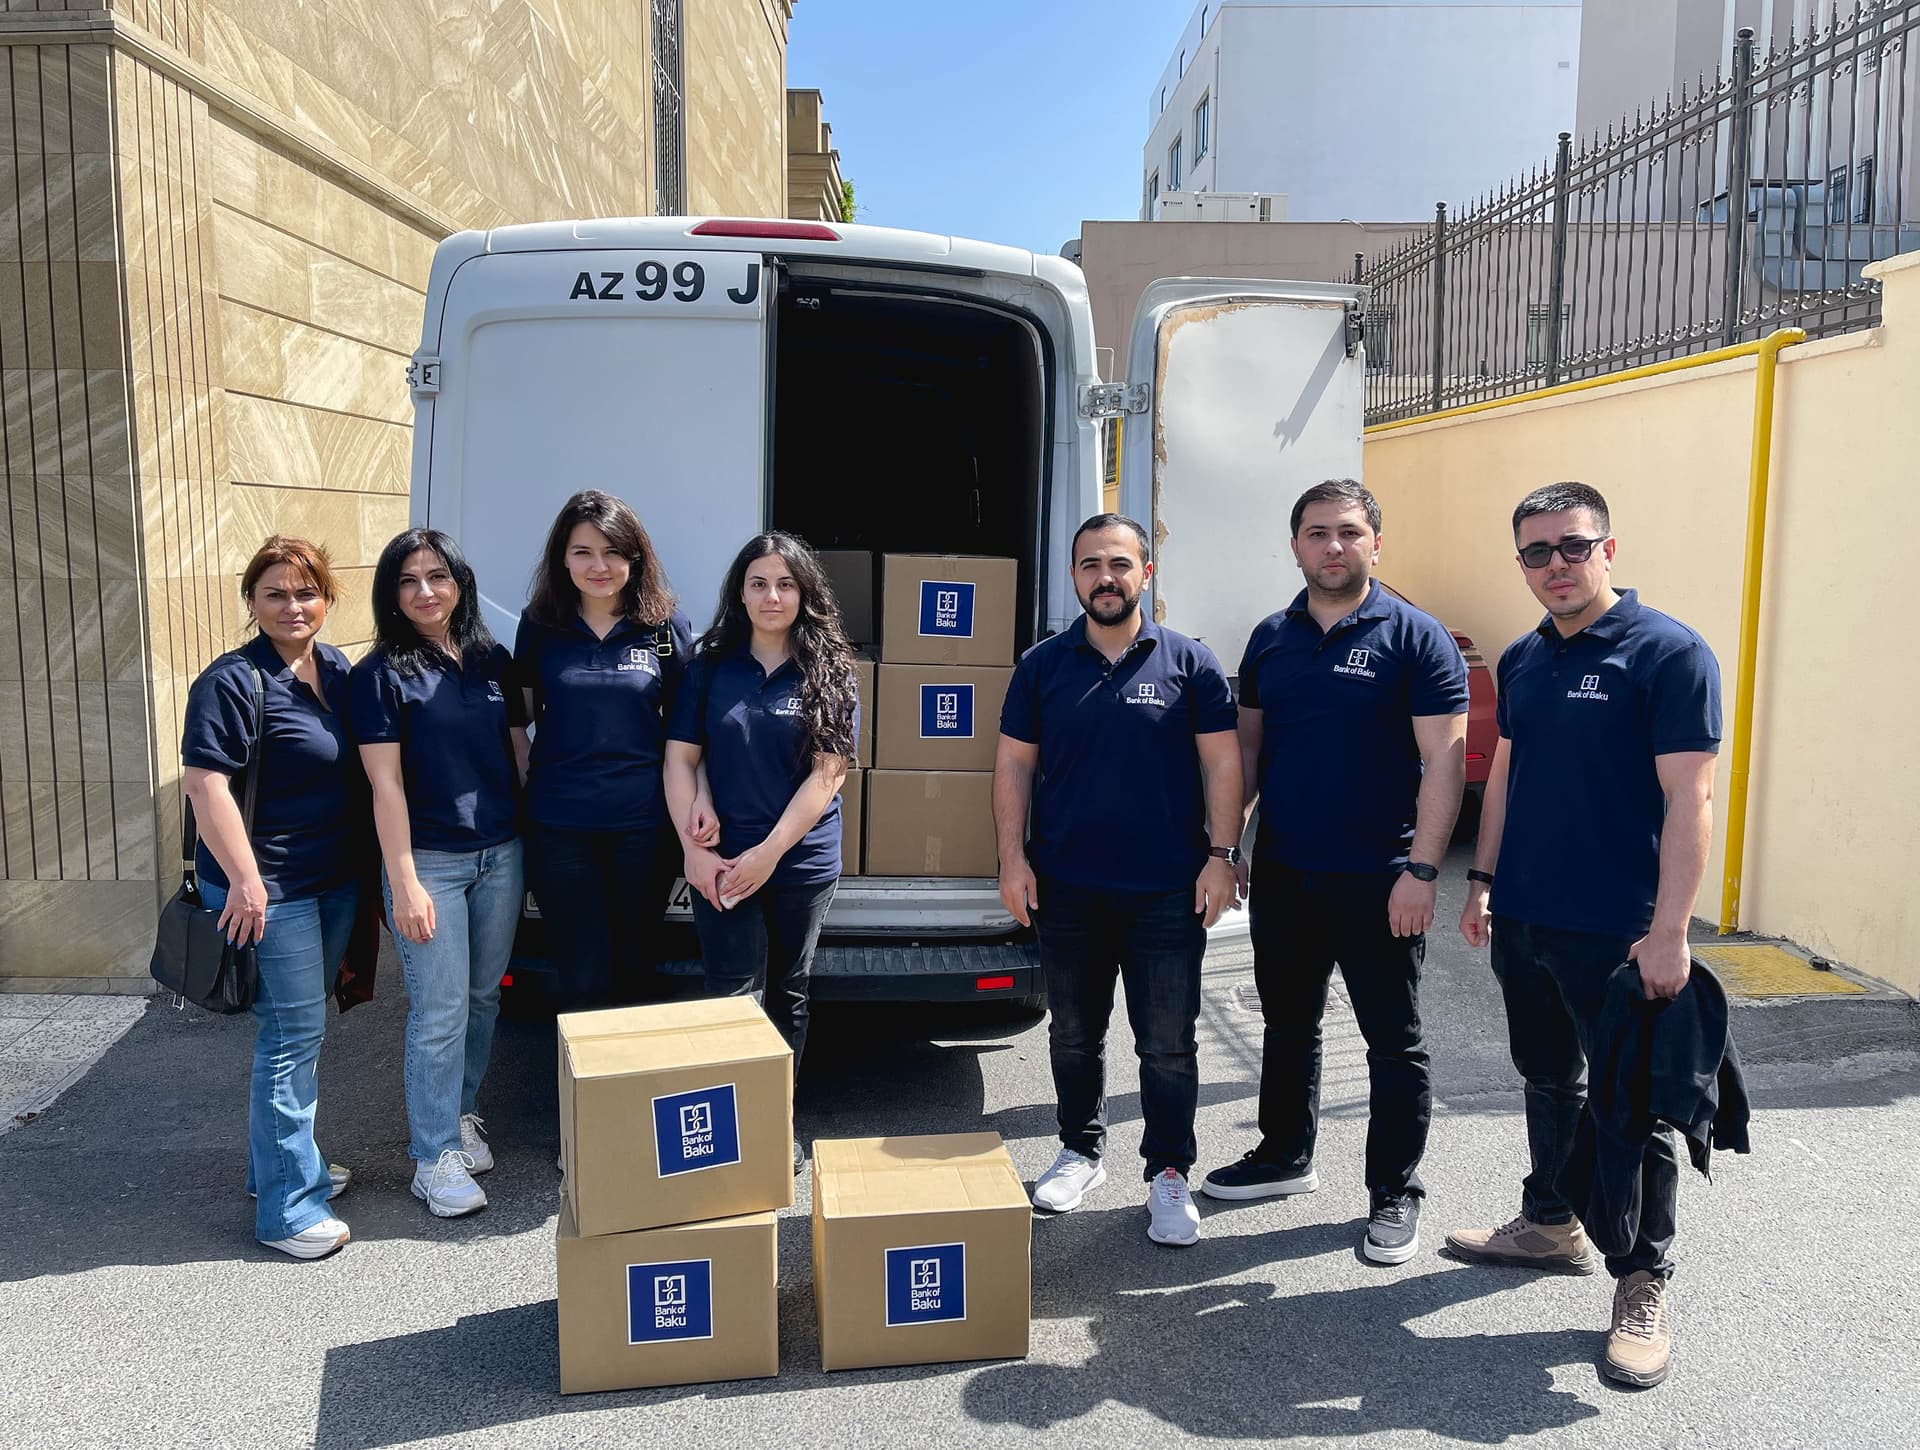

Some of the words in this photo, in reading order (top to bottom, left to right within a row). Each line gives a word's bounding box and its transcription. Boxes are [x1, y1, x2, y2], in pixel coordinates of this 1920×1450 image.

[569, 271, 624, 300] AZ
[635, 261, 705, 302] 99
[727, 263, 760, 305] J
[936, 611, 950, 619] Bank
[936, 618, 957, 628] Baku
[617, 663, 635, 671] Bank
[1333, 664, 1350, 674] Bank
[1350, 667, 1357, 675] of
[1357, 667, 1376, 678] Baku
[1126, 696, 1141, 704] Bank
[1142, 696, 1149, 704] of
[1148, 697, 1165, 706] Baku
[1567, 690, 1582, 698] Bank
[1582, 690, 1590, 699] of
[1589, 691, 1609, 701] Baku
[937, 719, 957, 729] Baku
[682, 1134, 704, 1146] Bank
[704, 1132, 713, 1142] of
[683, 1143, 714, 1158] Baku
[911, 1288, 932, 1299] Bank
[932, 1287, 940, 1297] of
[655, 1306, 677, 1316] Bank
[677, 1304, 686, 1314] of
[911, 1298, 941, 1311] Baku
[655, 1315, 687, 1328] Baku
